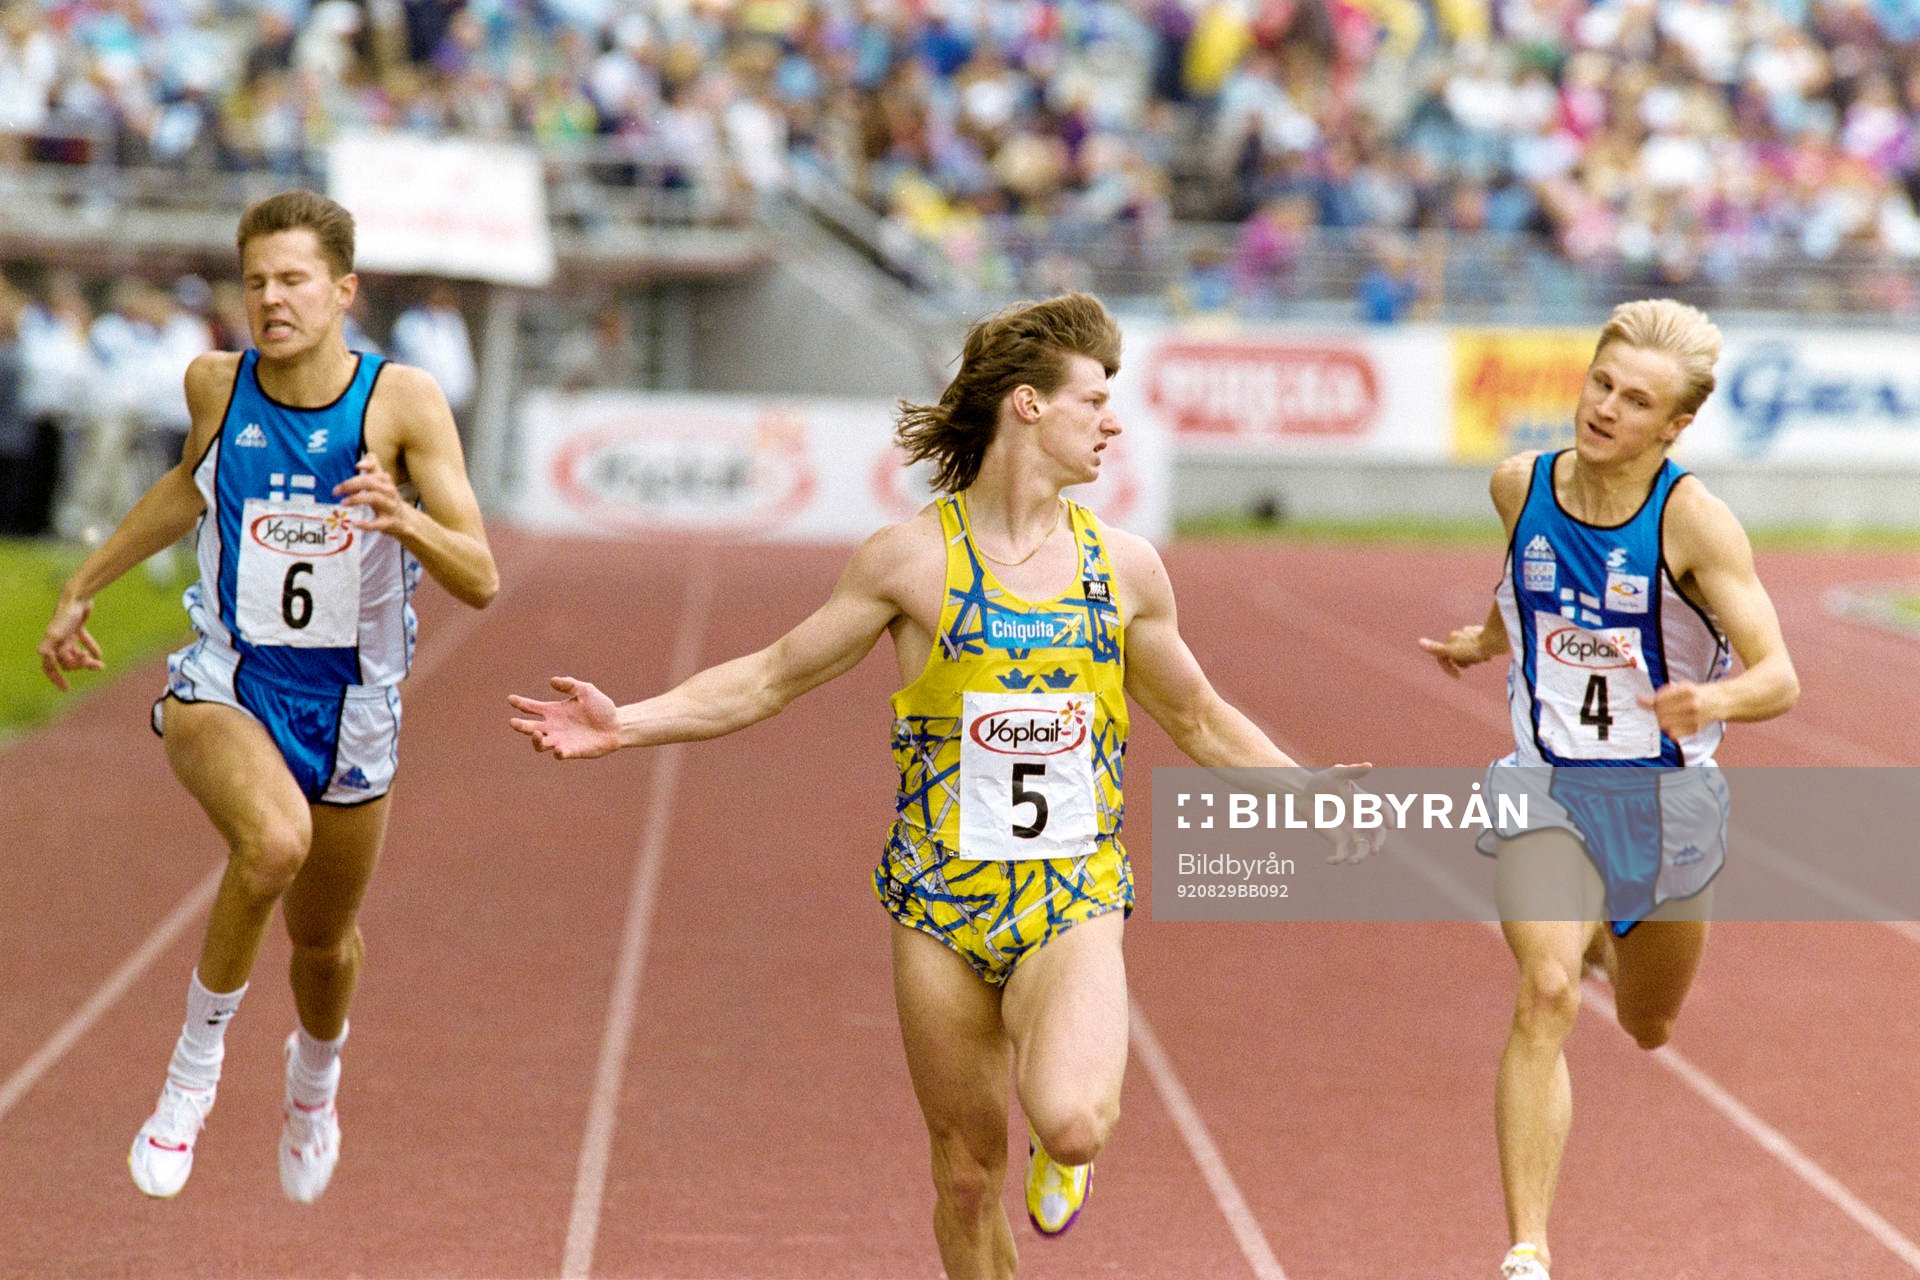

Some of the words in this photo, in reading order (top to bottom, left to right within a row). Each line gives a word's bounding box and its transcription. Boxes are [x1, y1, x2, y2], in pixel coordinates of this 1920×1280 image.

[264, 519, 327, 549] Yoplait
[281, 562, 314, 629] 6
[991, 620, 1055, 645] Chiquita
[1580, 674, 1613, 741] 4
[984, 718, 1062, 748] Yoplait
[1012, 763, 1048, 839] 5
